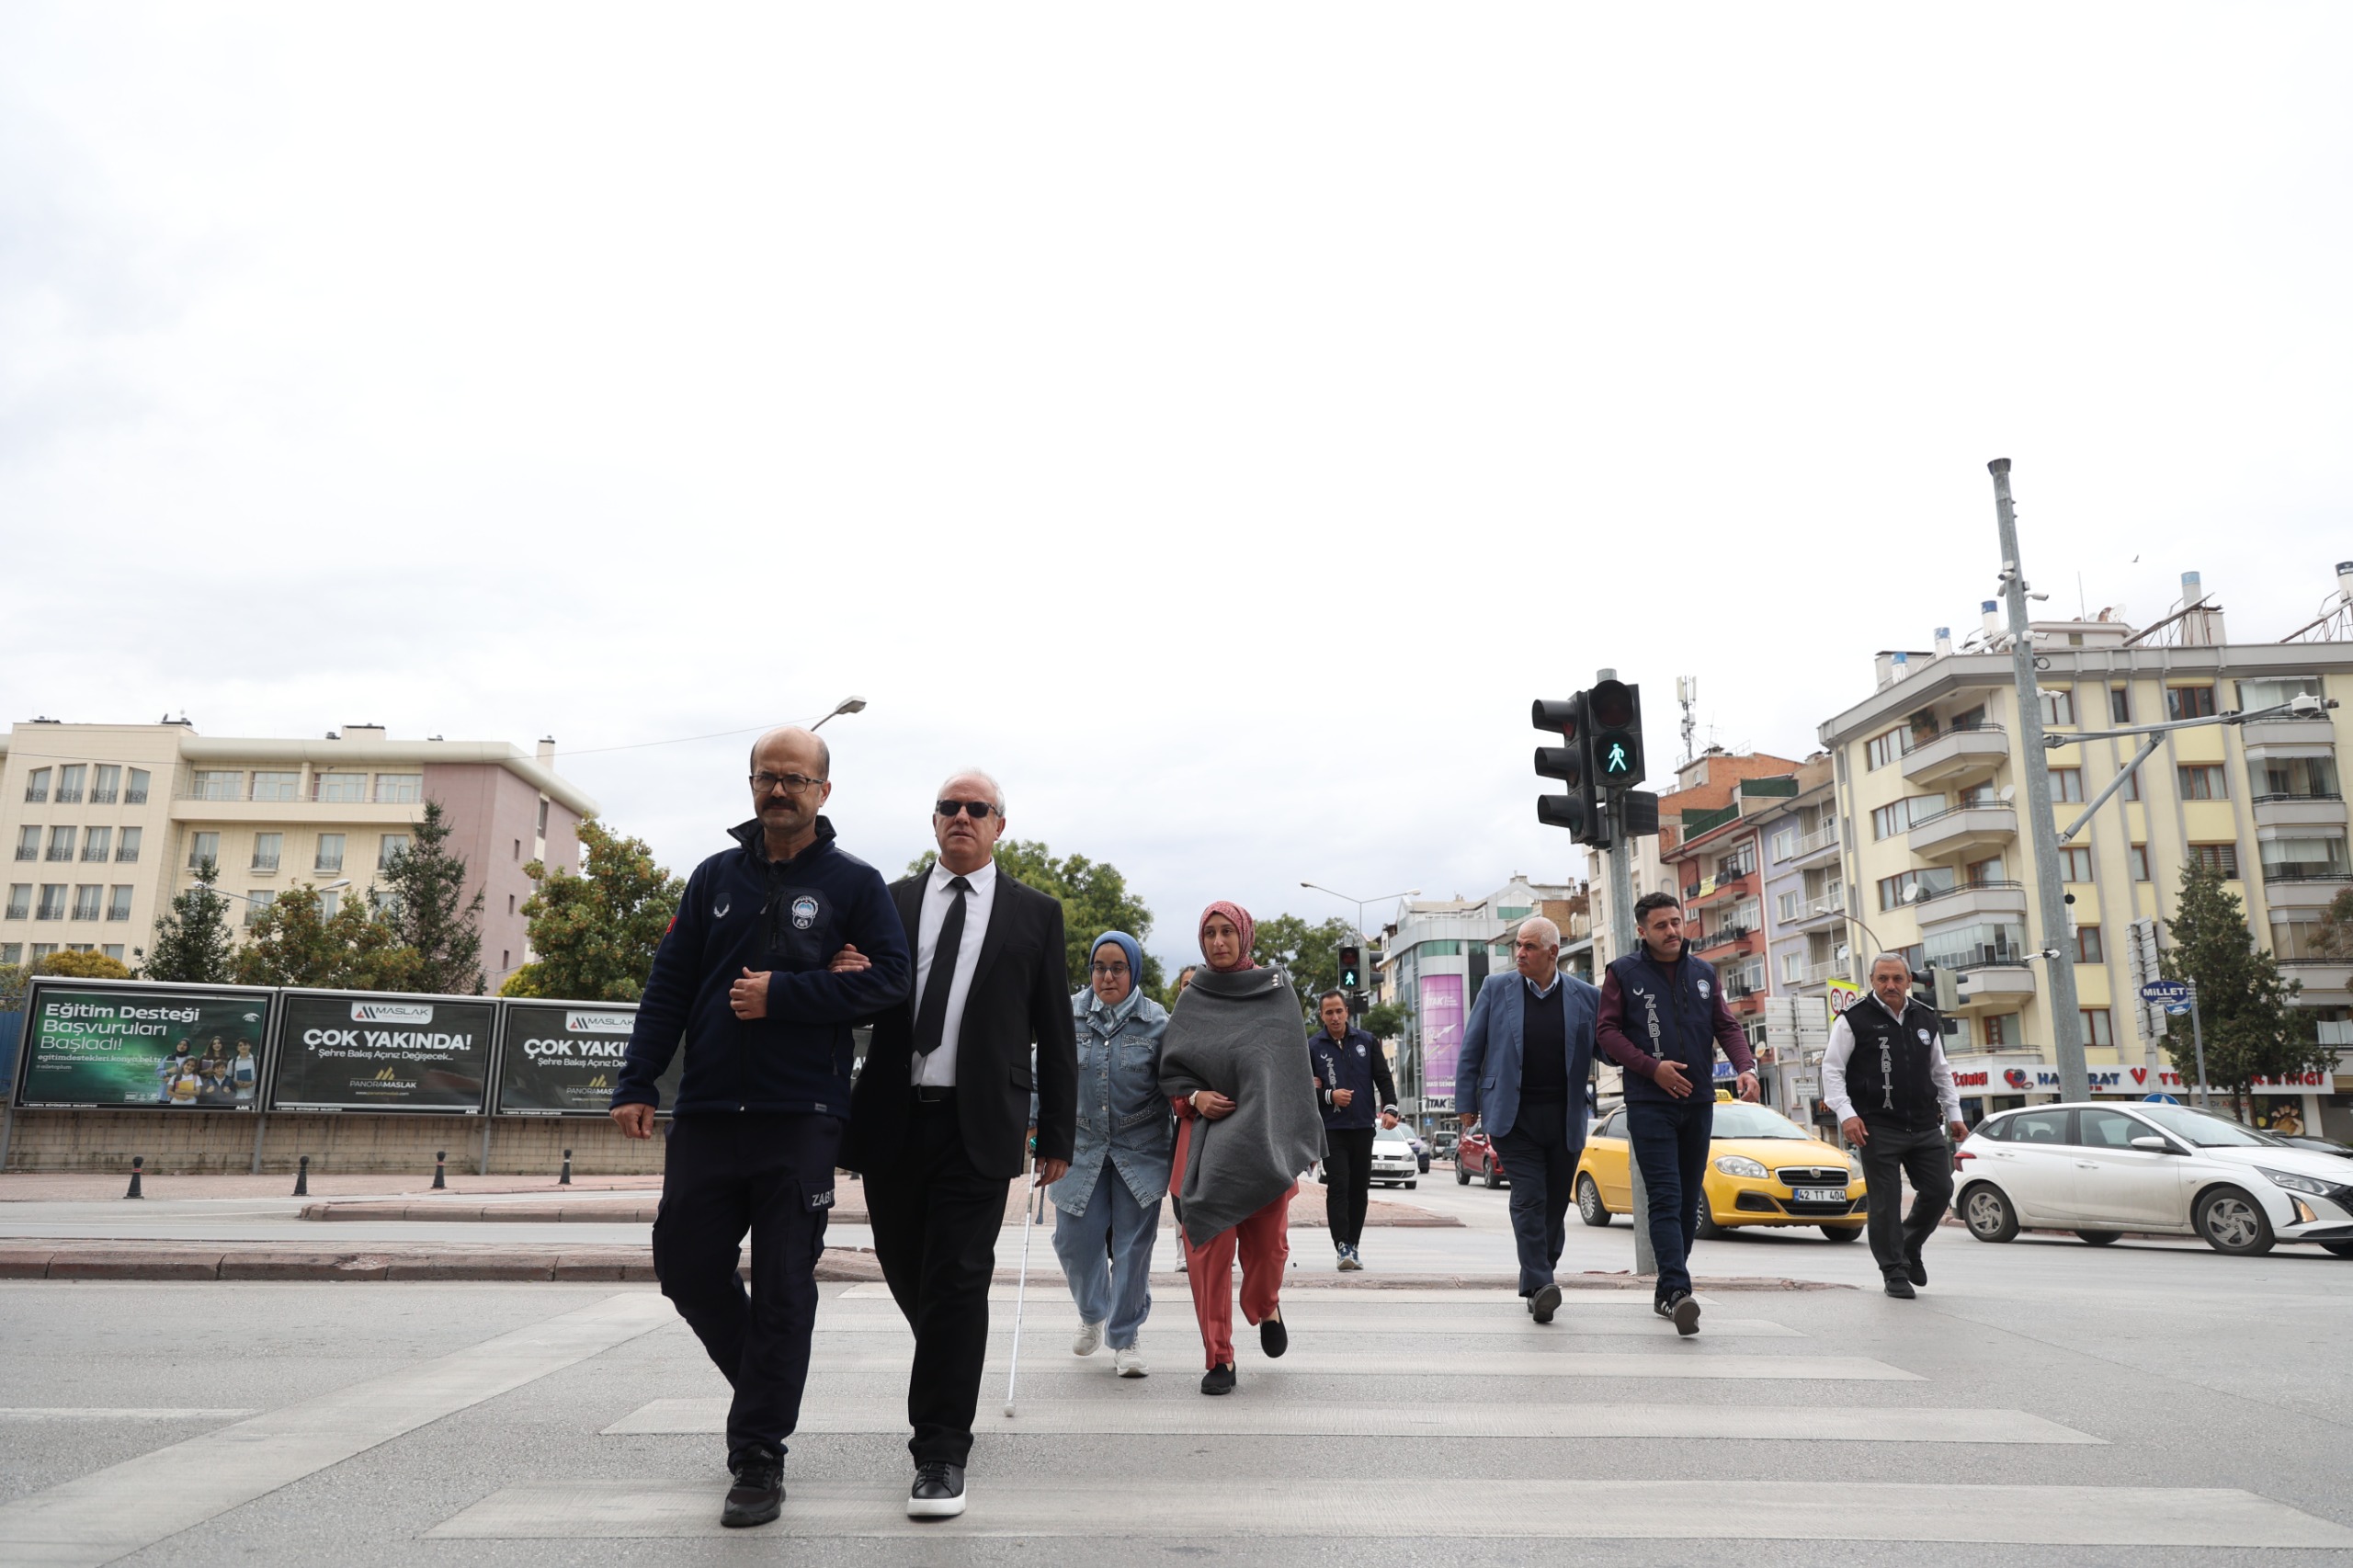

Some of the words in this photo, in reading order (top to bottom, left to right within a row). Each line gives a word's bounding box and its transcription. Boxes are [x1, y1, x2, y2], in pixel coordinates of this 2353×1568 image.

[45, 1003, 114, 1018] Eğitim
[119, 1006, 200, 1022] Desteği
[376, 1007, 429, 1016] MASLAK
[43, 1019, 167, 1036] Başvuruları
[588, 1017, 635, 1026] MASLAK
[1643, 994, 1665, 1062] ZABIT
[40, 1036, 122, 1051] Başladı!
[302, 1028, 359, 1051] ÇOK
[363, 1030, 472, 1051] YAKINDA!
[318, 1049, 347, 1059] Şehre
[347, 1049, 373, 1059] Bakış
[375, 1051, 401, 1060] Açınız
[524, 1039, 574, 1059] ÇOK
[577, 1040, 629, 1057] YAKI
[538, 1057, 562, 1067] Şehre
[563, 1058, 586, 1068] Bakış
[587, 1060, 611, 1068] Açınız
[1878, 1037, 1893, 1109] ZABITA
[2037, 1073, 2120, 1085] HARAT
[349, 1080, 417, 1088] PANORAMASLAK
[1799, 1190, 1810, 1200] 42
[1814, 1190, 1824, 1200] TT
[1829, 1190, 1845, 1200] 404
